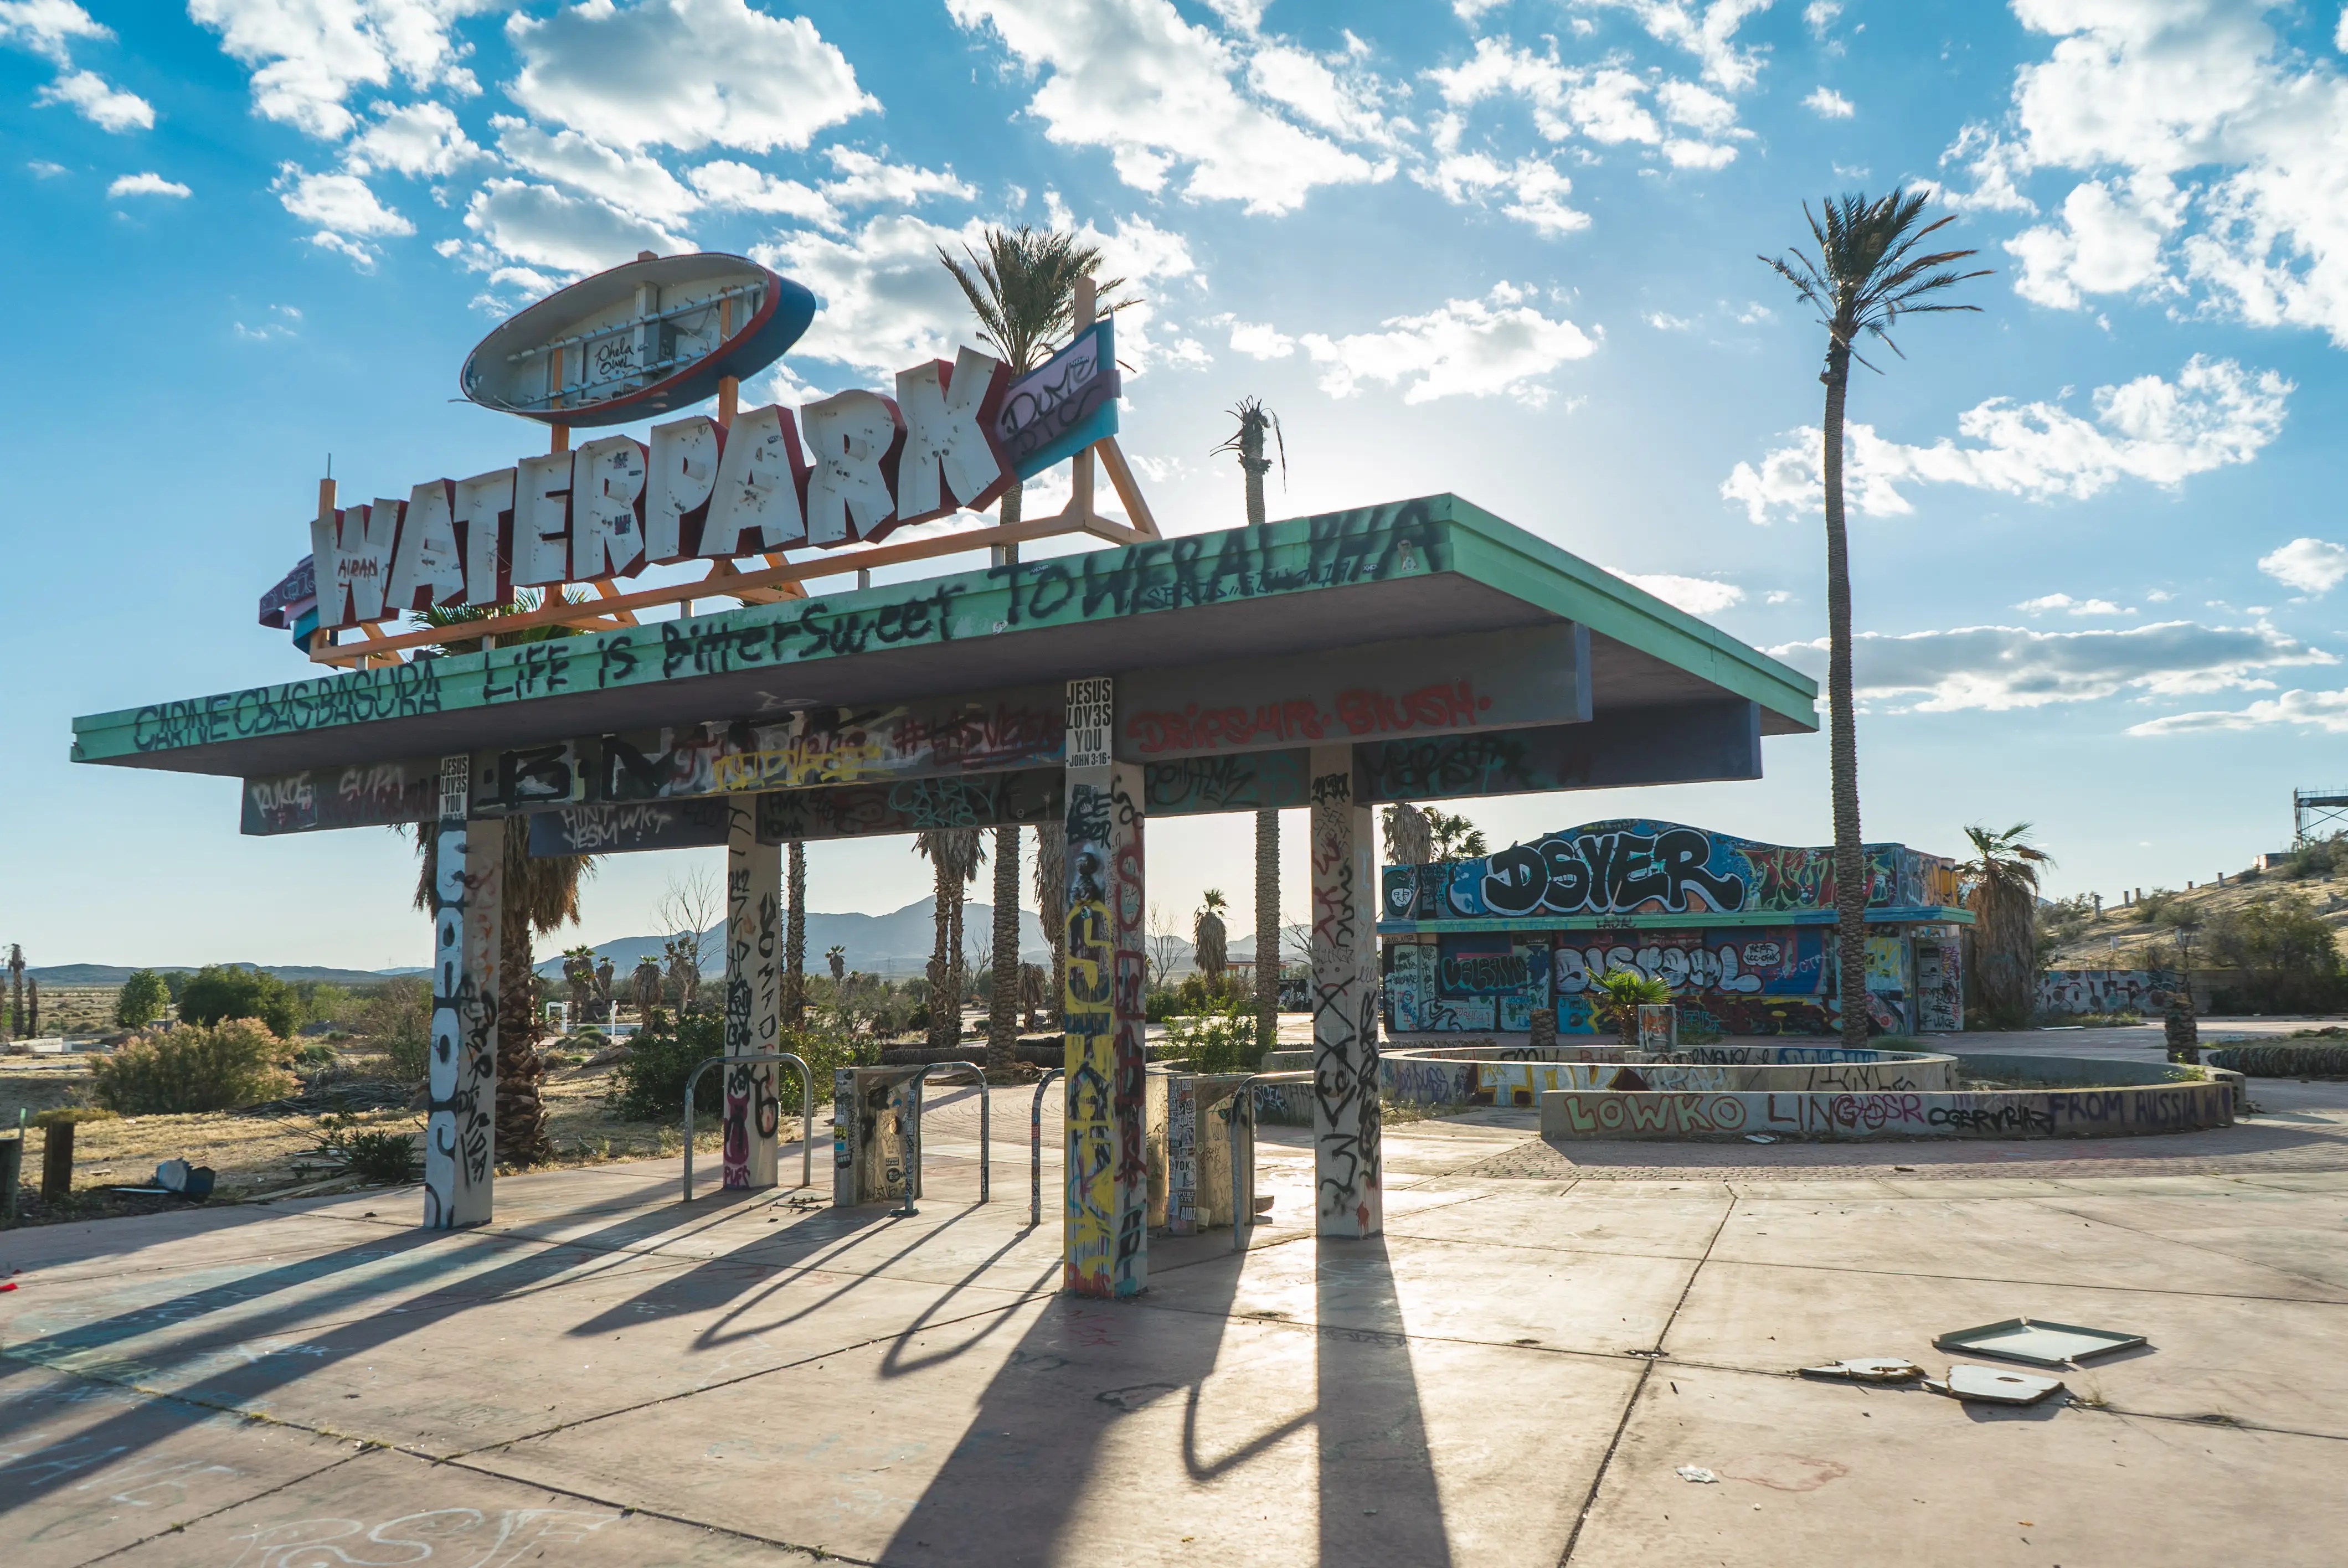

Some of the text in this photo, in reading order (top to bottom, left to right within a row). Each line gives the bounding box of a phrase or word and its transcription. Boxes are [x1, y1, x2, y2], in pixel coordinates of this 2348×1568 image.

[309, 345, 1012, 629] WATERPARK
[1067, 679, 1111, 706] JESUS
[1065, 703, 1111, 729] LOV3S
[1074, 728, 1102, 753] YOU
[441, 756, 467, 776] JESUS
[1069, 752, 1107, 767] JOHN 3:16
[441, 775, 467, 795] LOV3S
[445, 794, 461, 813] YOU
[1563, 1095, 1748, 1135] LOWKO
[2048, 1090, 2124, 1125] FROM
[2135, 1089, 2198, 1125] RUSSIA
